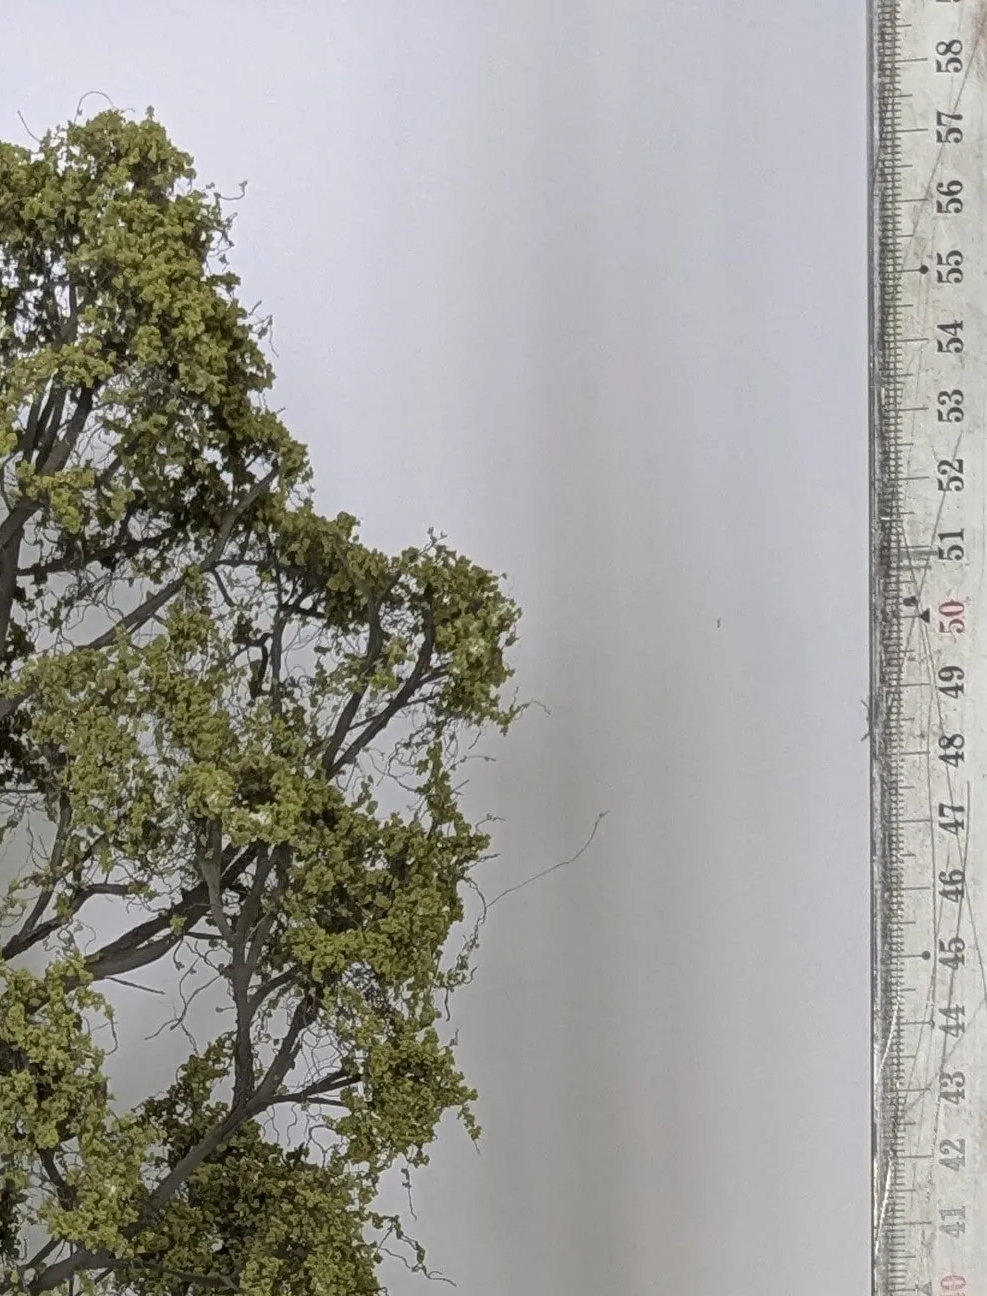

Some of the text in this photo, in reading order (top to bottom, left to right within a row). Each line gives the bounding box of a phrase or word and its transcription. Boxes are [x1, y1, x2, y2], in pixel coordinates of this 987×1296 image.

[936, 40, 962, 73] 58
[936, 111, 963, 143] 57
[936, 180, 963, 213] 56
[937, 250, 963, 283] 55
[937, 320, 963, 353] 54
[937, 390, 964, 422] 53
[937, 459, 964, 492] 52
[938, 528, 964, 560] 51
[939, 600, 964, 633] 50
[938, 666, 964, 699] 49
[938, 733, 964, 766] 48
[939, 803, 965, 836] 47
[938, 869, 965, 903] 46
[938, 937, 965, 970] 45
[938, 1004, 965, 1038] 44
[938, 1071, 965, 1105] 43
[939, 1139, 965, 1171] 42
[939, 1206, 966, 1238] 41
